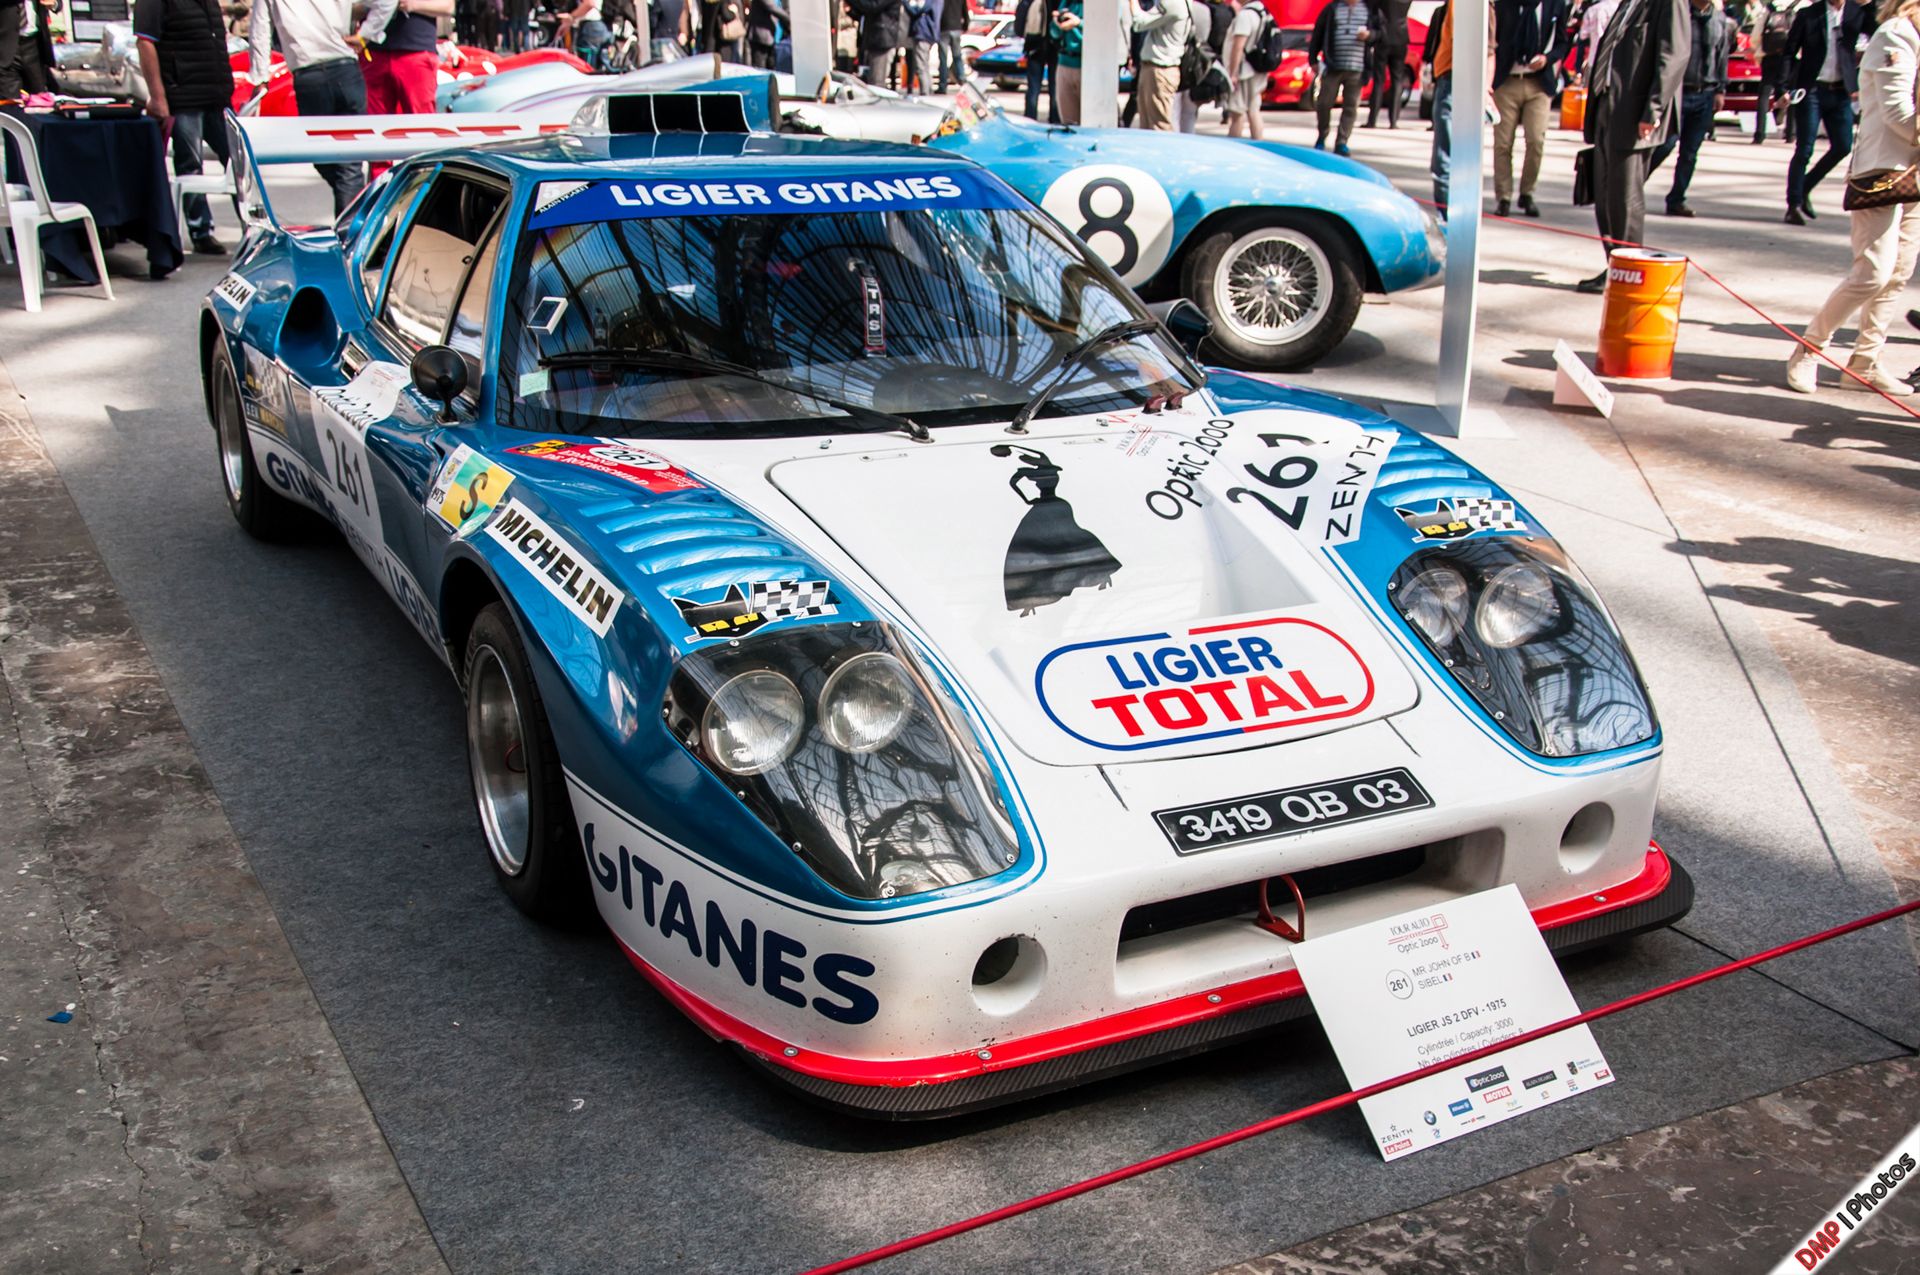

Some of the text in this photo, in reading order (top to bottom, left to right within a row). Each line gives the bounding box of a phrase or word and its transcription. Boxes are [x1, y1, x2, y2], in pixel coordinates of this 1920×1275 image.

[609, 175, 962, 207] LIGIER GITANES
[1077, 176, 1140, 278] 8
[327, 427, 370, 518] 261
[594, 449, 661, 466] 261
[1145, 418, 1235, 521] Optic 2000
[459, 471, 489, 521] S
[1226, 433, 1330, 531] 261
[494, 507, 615, 625] MICHELIN
[1106, 636, 1283, 690] LIGIER
[1091, 670, 1349, 737] TOTAL
[1179, 779, 1410, 842] 3419 QB 03
[584, 822, 880, 1025] GITANES
[1389, 917, 1431, 936] TOUR AUTO
[1397, 938, 1419, 953] Optic
[1411, 953, 1471, 977] MR JOHN OF B
[1389, 977, 1409, 992] 261
[1417, 976, 1443, 990] SIBEL
[1406, 1019, 1440, 1037] LIGIER
[1441, 1015, 1453, 1027] JS
[1453, 1013, 1460, 1023] 2
[1460, 1006, 1480, 1020] DFV
[1486, 998, 1508, 1012] 1975
[1494, 1017, 1515, 1031] 3000
[1486, 1087, 1511, 1102] MOTUL
[1380, 1127, 1413, 1144] ZENITH
